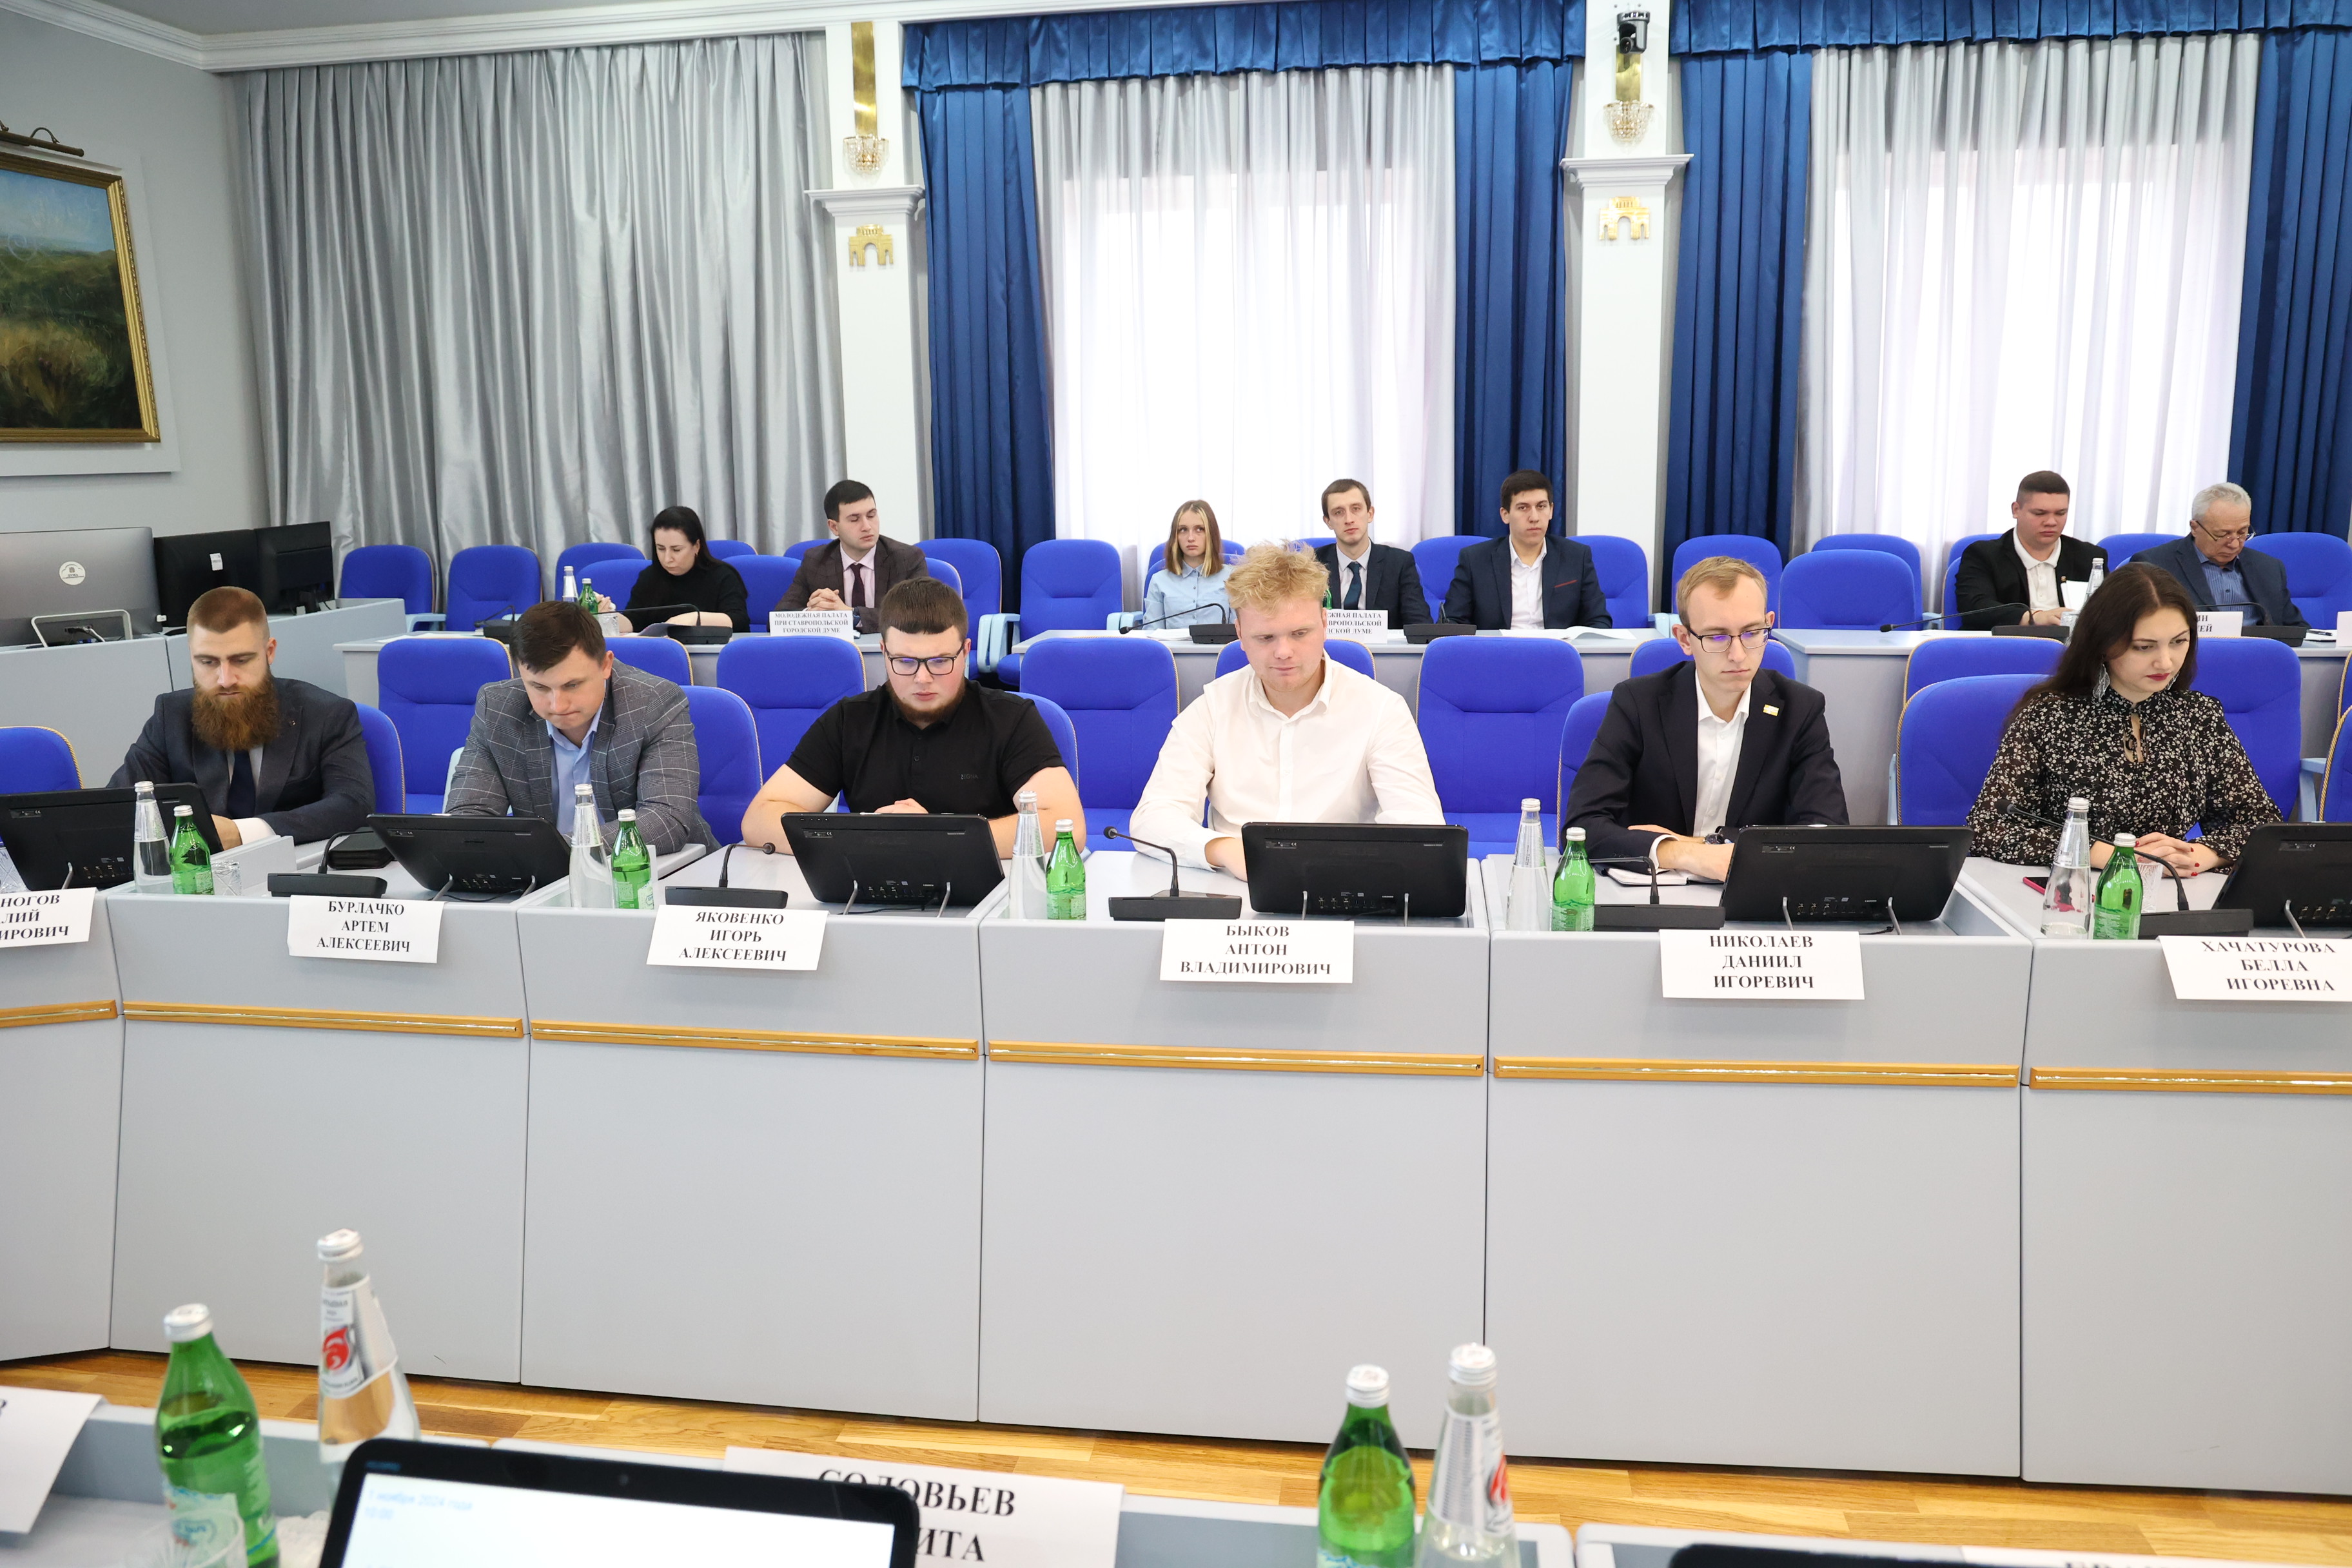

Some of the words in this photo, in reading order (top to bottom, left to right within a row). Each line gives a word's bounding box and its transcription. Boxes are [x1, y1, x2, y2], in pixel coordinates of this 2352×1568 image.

[0, 894, 60, 908] НОГОВ
[328, 900, 406, 916] БУРЛАЧКО
[0, 908, 41, 924] ЛИЙ
[694, 911, 785, 925] ЯКОВЕНКО
[0, 925, 69, 941] ИРОВИЧ
[340, 919, 390, 934] АРТЕМ
[1226, 925, 1290, 937] БЫКОВ
[709, 928, 763, 943] ИГОРЬ
[1709, 935, 1814, 948] НИКОЛАЕВ
[316, 936, 411, 953] АЛЕКСЕЕВИЧ
[1225, 943, 1288, 956] АНТОН
[2200, 941, 2337, 954] ХАЧАТУРОВА
[678, 946, 787, 963] АЛЕКСЕЕВИЧ
[1721, 954, 1802, 970] ДАНИИЛ
[1180, 961, 1331, 975] ВЛАДИМИРОВИЧ
[2240, 959, 2309, 972] БЕЛЛА
[1713, 975, 1814, 989] ИГОРЕВИЧ
[2226, 977, 2335, 992] ИГОРЕВНА
[917, 1527, 985, 1563] ИТА
